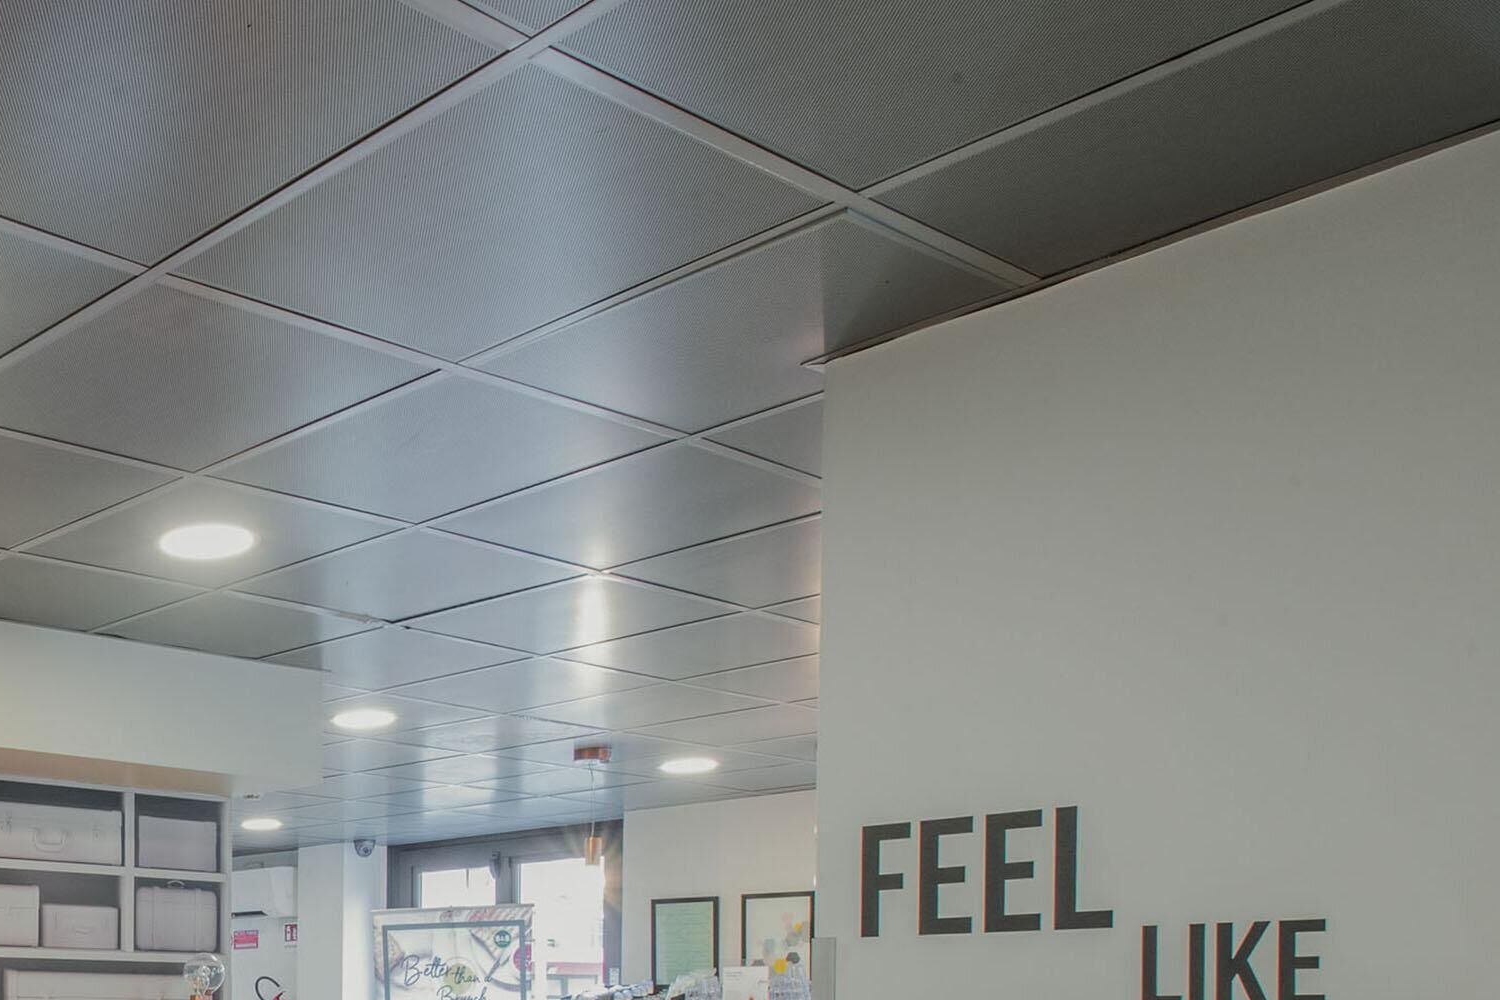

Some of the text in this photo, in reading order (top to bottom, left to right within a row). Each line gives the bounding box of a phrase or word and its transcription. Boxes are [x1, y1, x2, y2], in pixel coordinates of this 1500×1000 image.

[860, 805, 1113, 937] FEEL
[402, 954, 451, 986] Better
[451, 965, 481, 984] than
